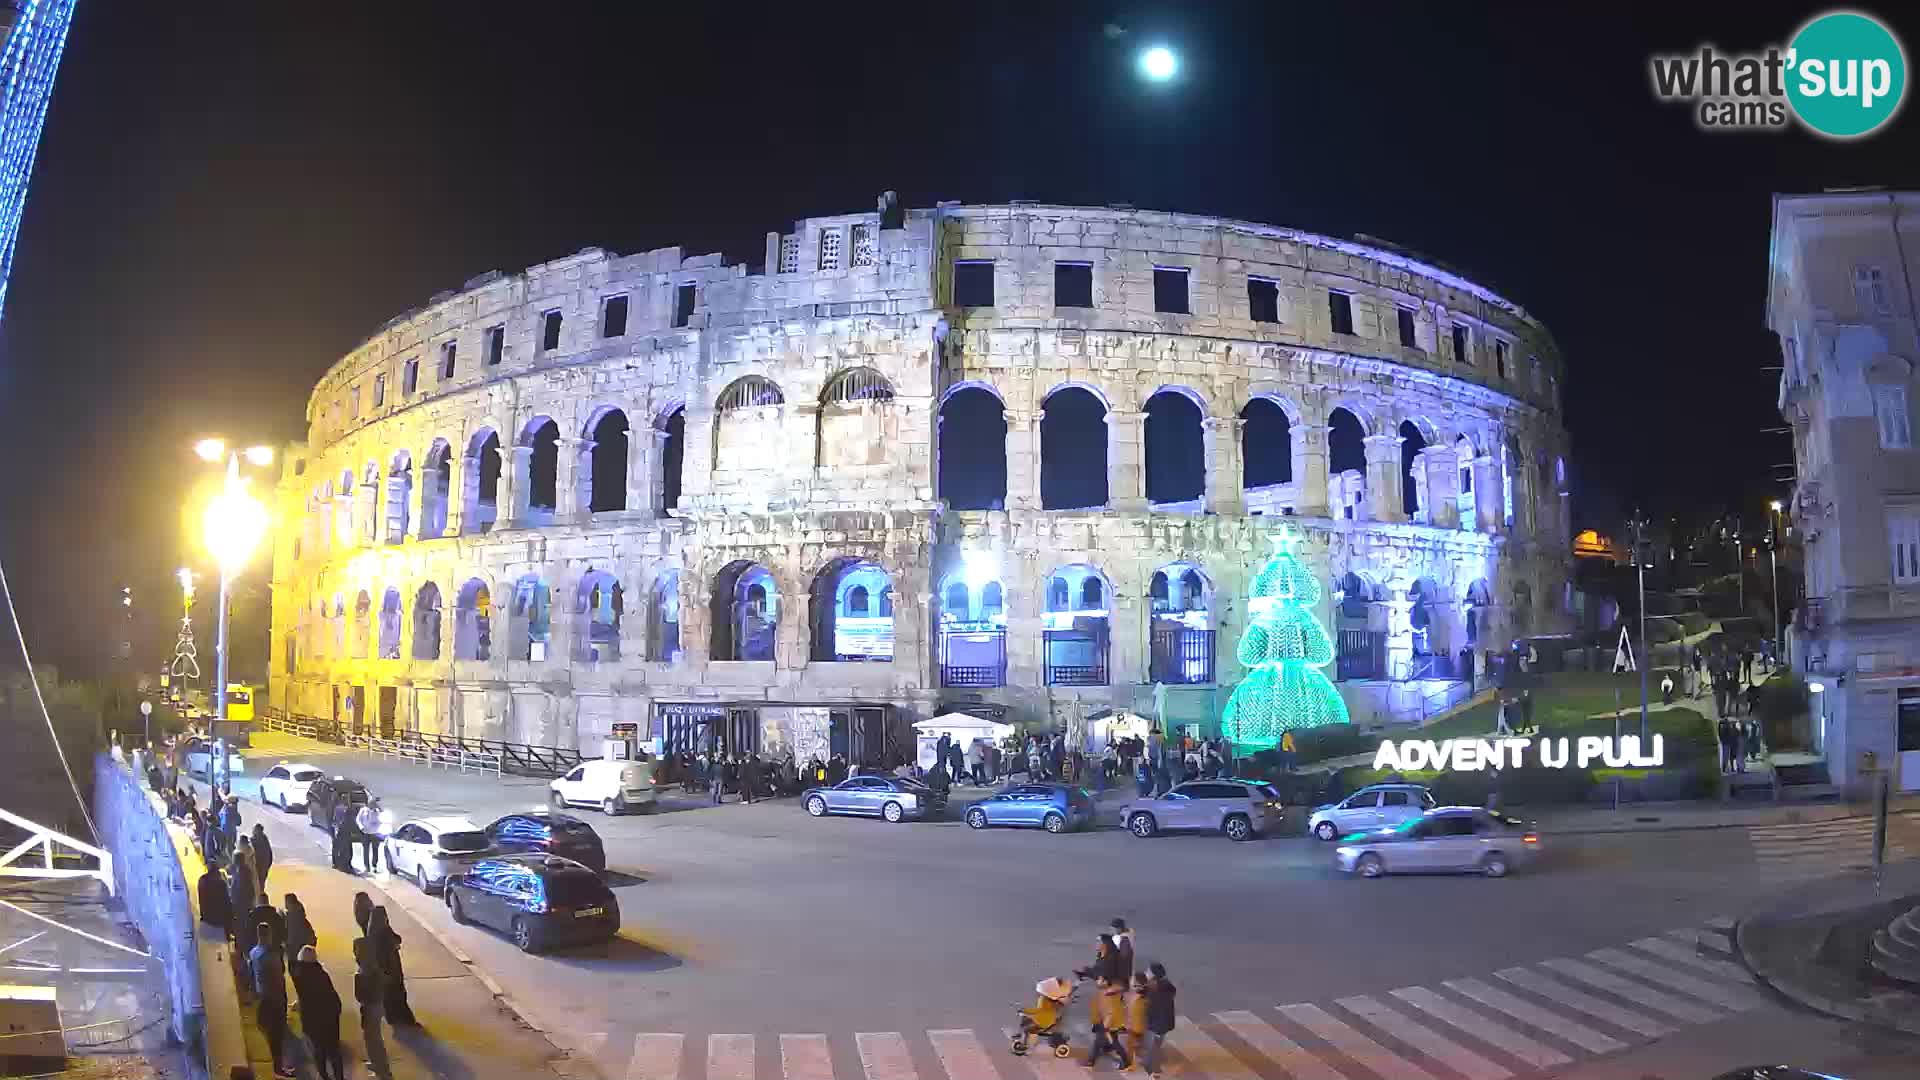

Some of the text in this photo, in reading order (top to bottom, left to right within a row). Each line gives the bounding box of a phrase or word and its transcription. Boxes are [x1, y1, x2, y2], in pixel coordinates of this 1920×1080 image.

[1373, 733, 1664, 771] ADVENT U PULI
